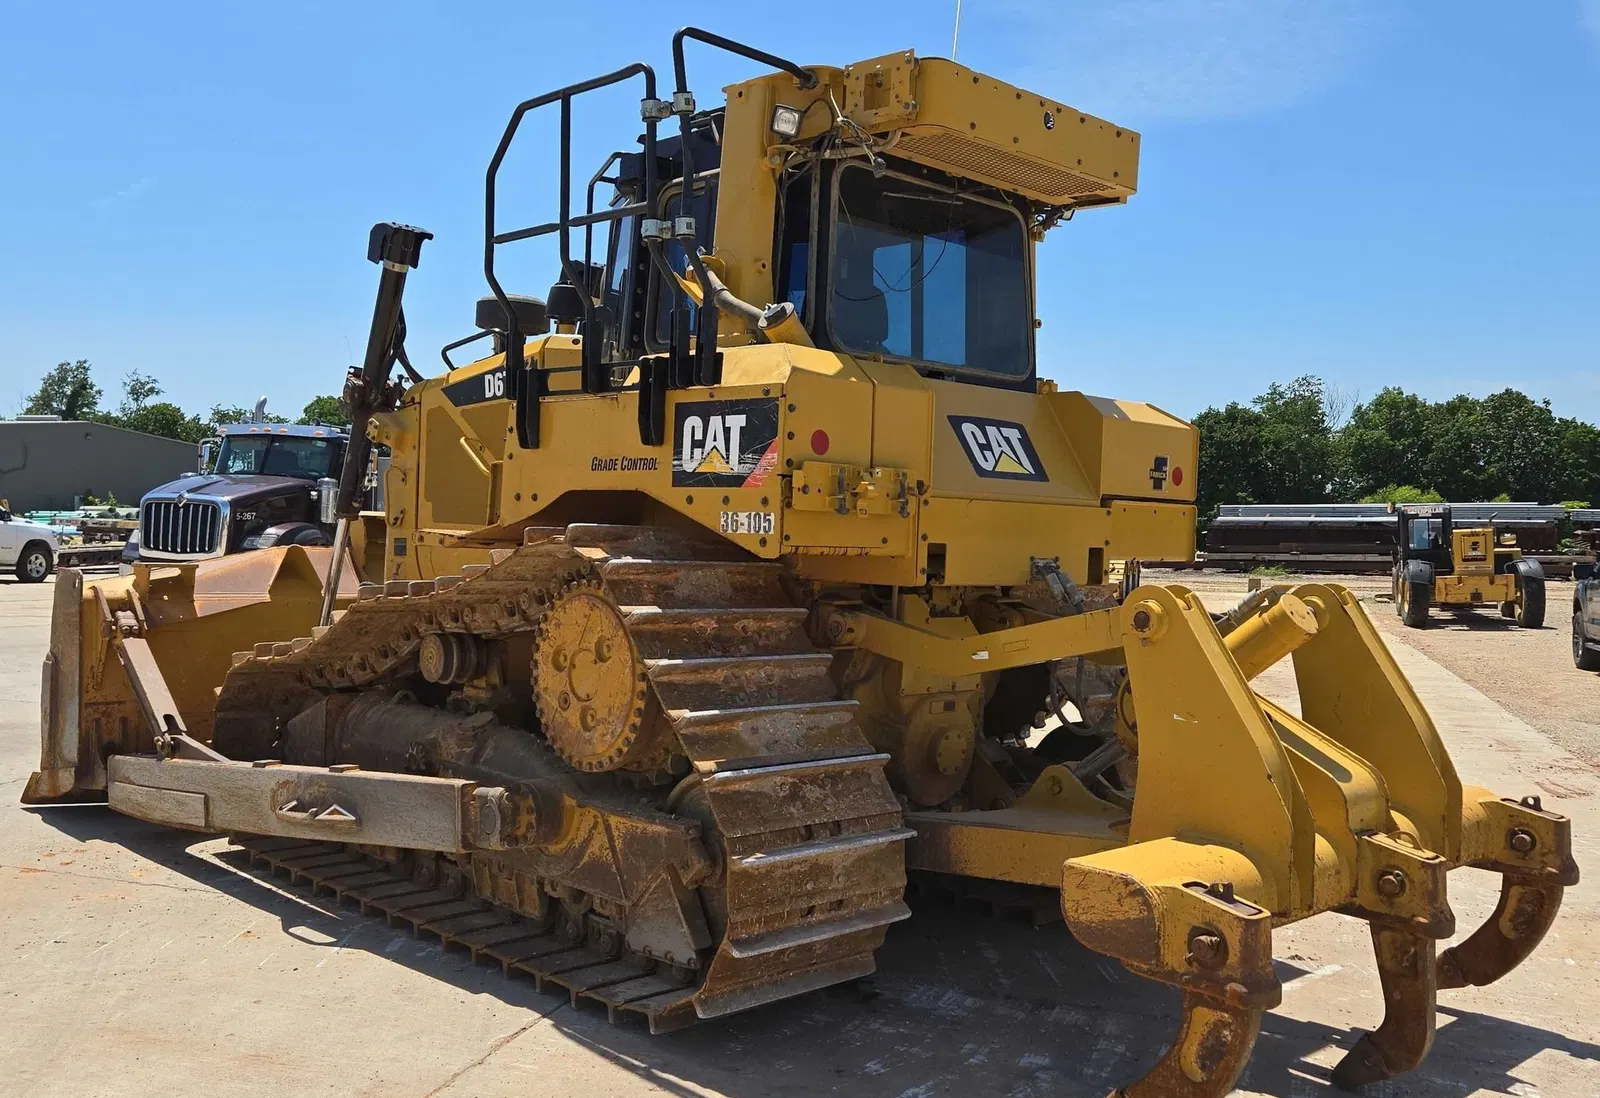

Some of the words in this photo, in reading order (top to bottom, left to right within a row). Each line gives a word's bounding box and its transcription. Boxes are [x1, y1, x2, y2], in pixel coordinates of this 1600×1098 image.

[484, 370, 507, 398] D6
[682, 414, 746, 473] CAT
[961, 422, 1036, 474] CAT
[236, 512, 257, 521] 5-267
[721, 511, 772, 533] 36-105
